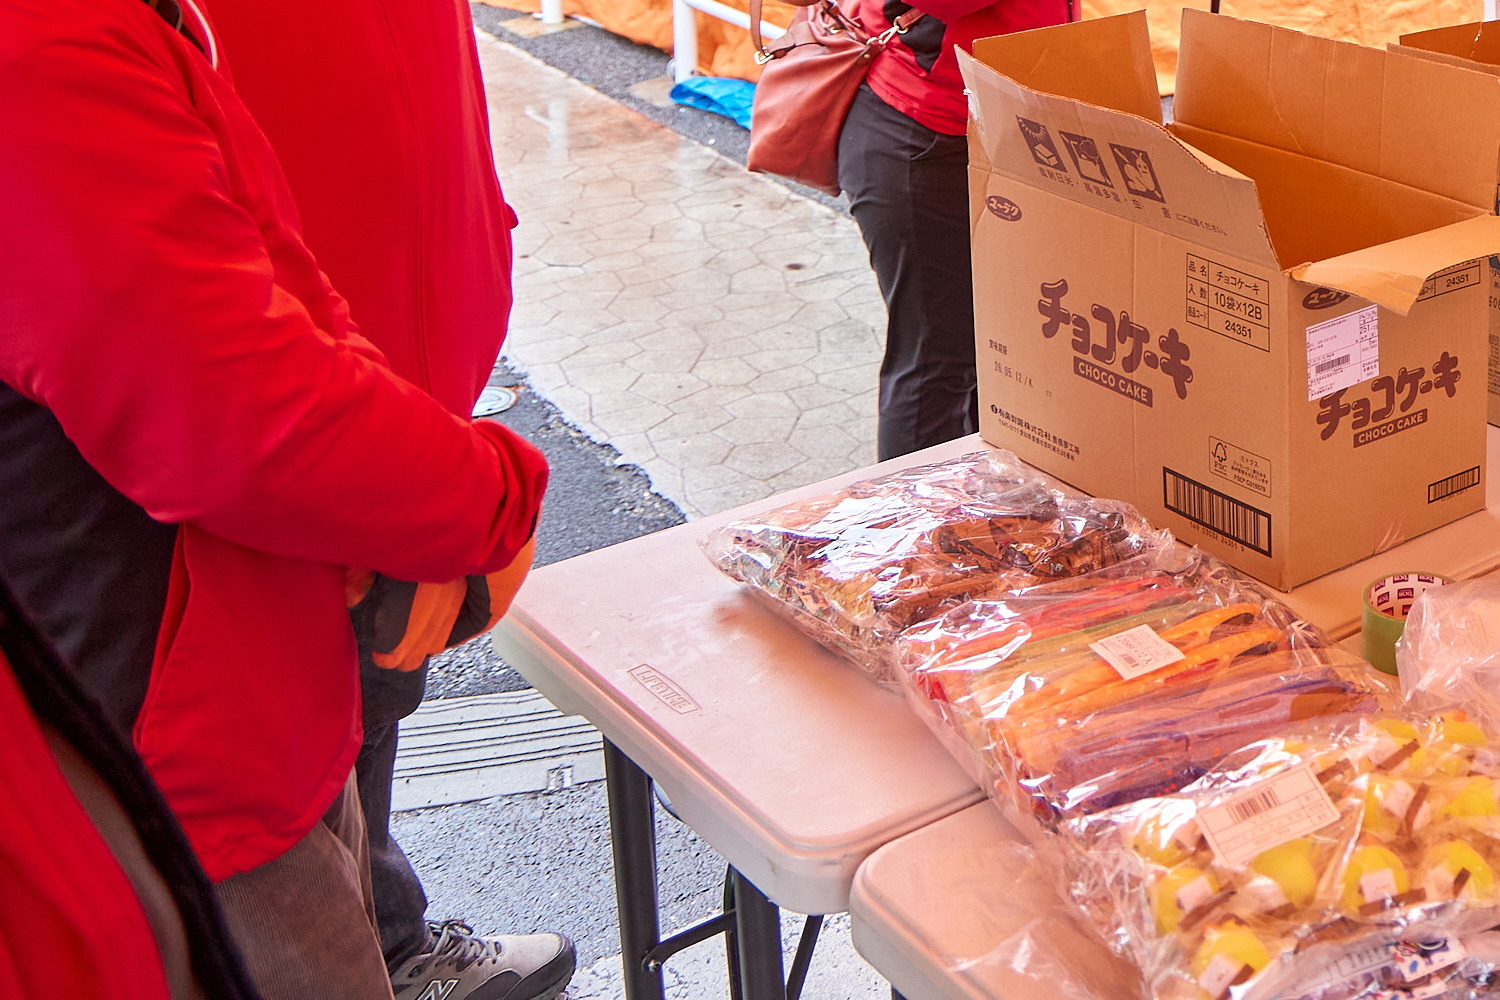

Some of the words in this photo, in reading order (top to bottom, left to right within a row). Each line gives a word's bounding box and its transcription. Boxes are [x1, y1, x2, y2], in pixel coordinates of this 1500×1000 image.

[1216, 270, 1260, 294] チョコケーキ
[1446, 274, 1469, 287] 24351
[1037, 278, 1194, 400] チョコケーキ
[1224, 320, 1252, 339] 24351
[1078, 361, 1116, 387] CHOCO
[1118, 378, 1148, 402] CAKE
[1316, 352, 1461, 441] チョコケーキ
[1358, 423, 1394, 444] CHOCO
[1397, 413, 1423, 430] CAKE
